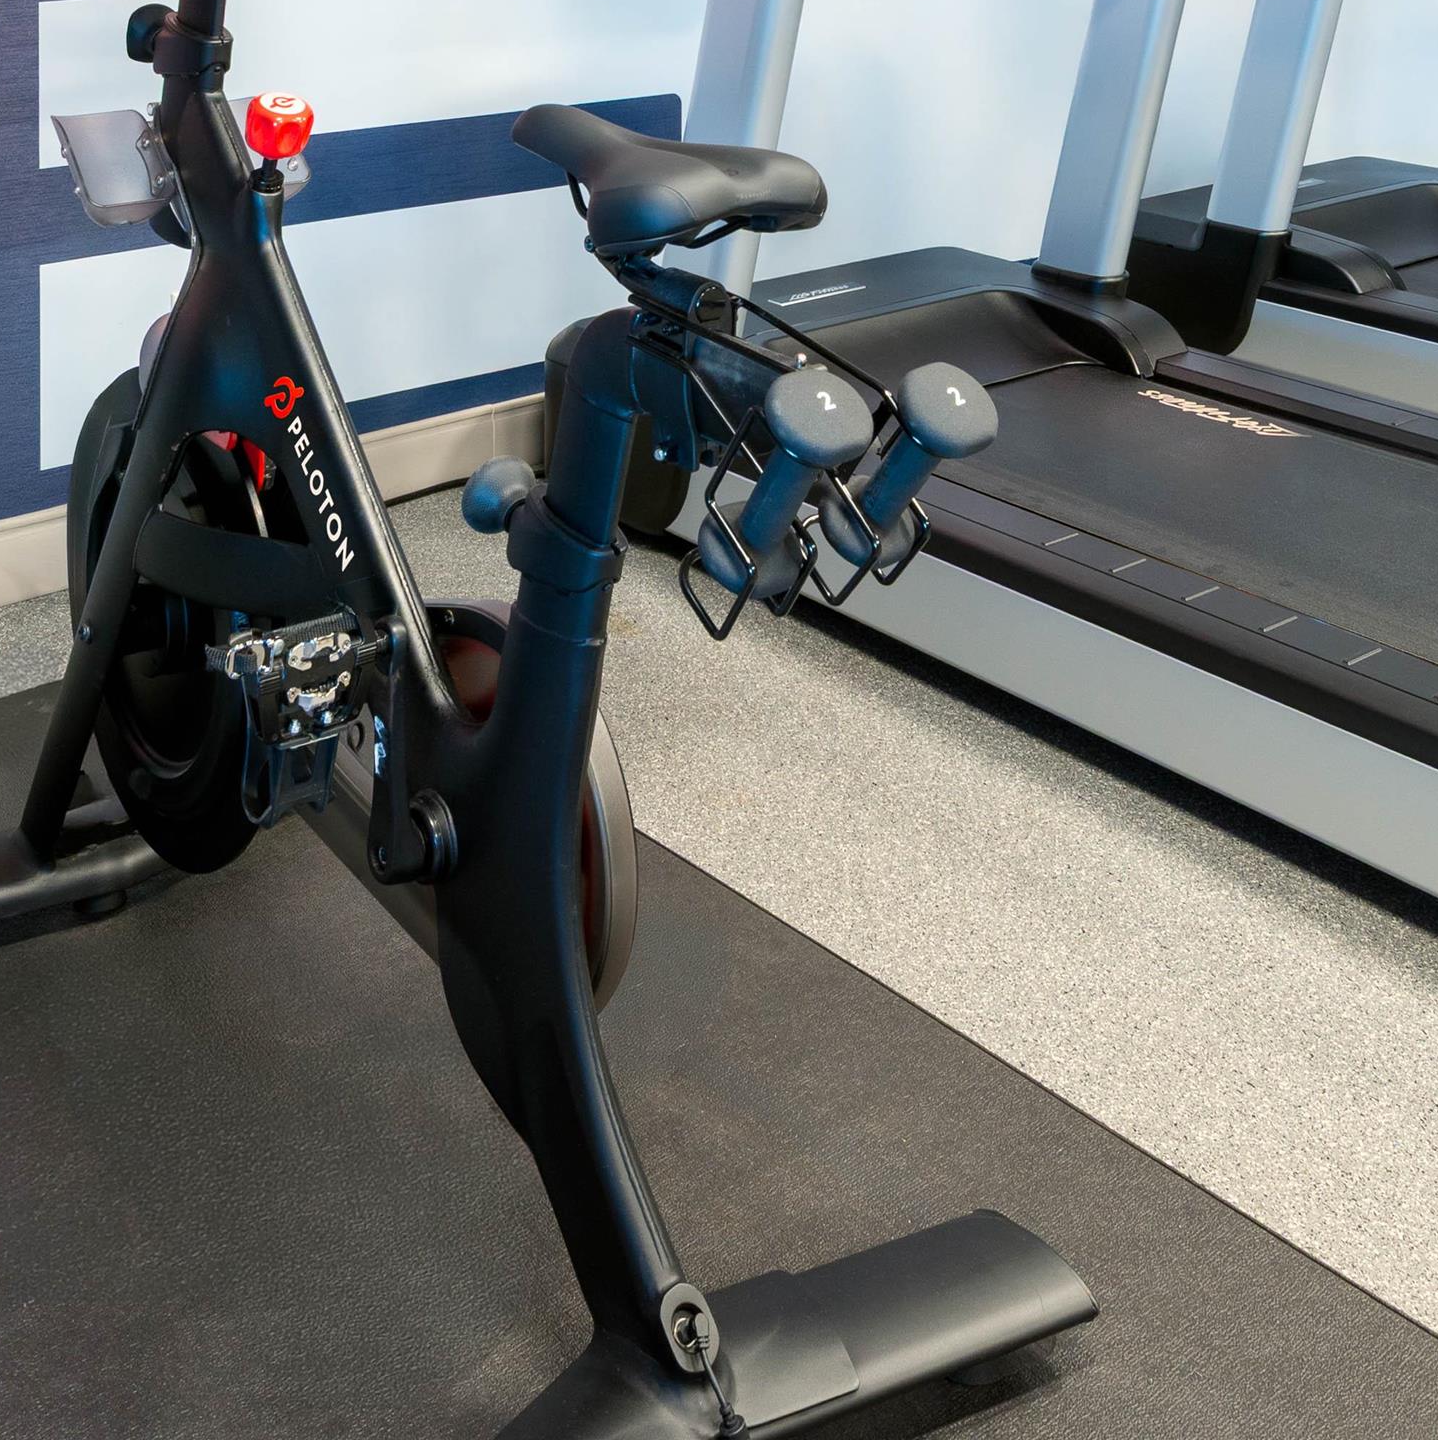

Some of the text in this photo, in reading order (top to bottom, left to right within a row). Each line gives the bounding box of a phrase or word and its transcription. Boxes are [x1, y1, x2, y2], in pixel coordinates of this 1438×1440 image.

[816, 391, 837, 411] 2
[946, 386, 967, 407] 2
[287, 415, 355, 573] PELOTON
